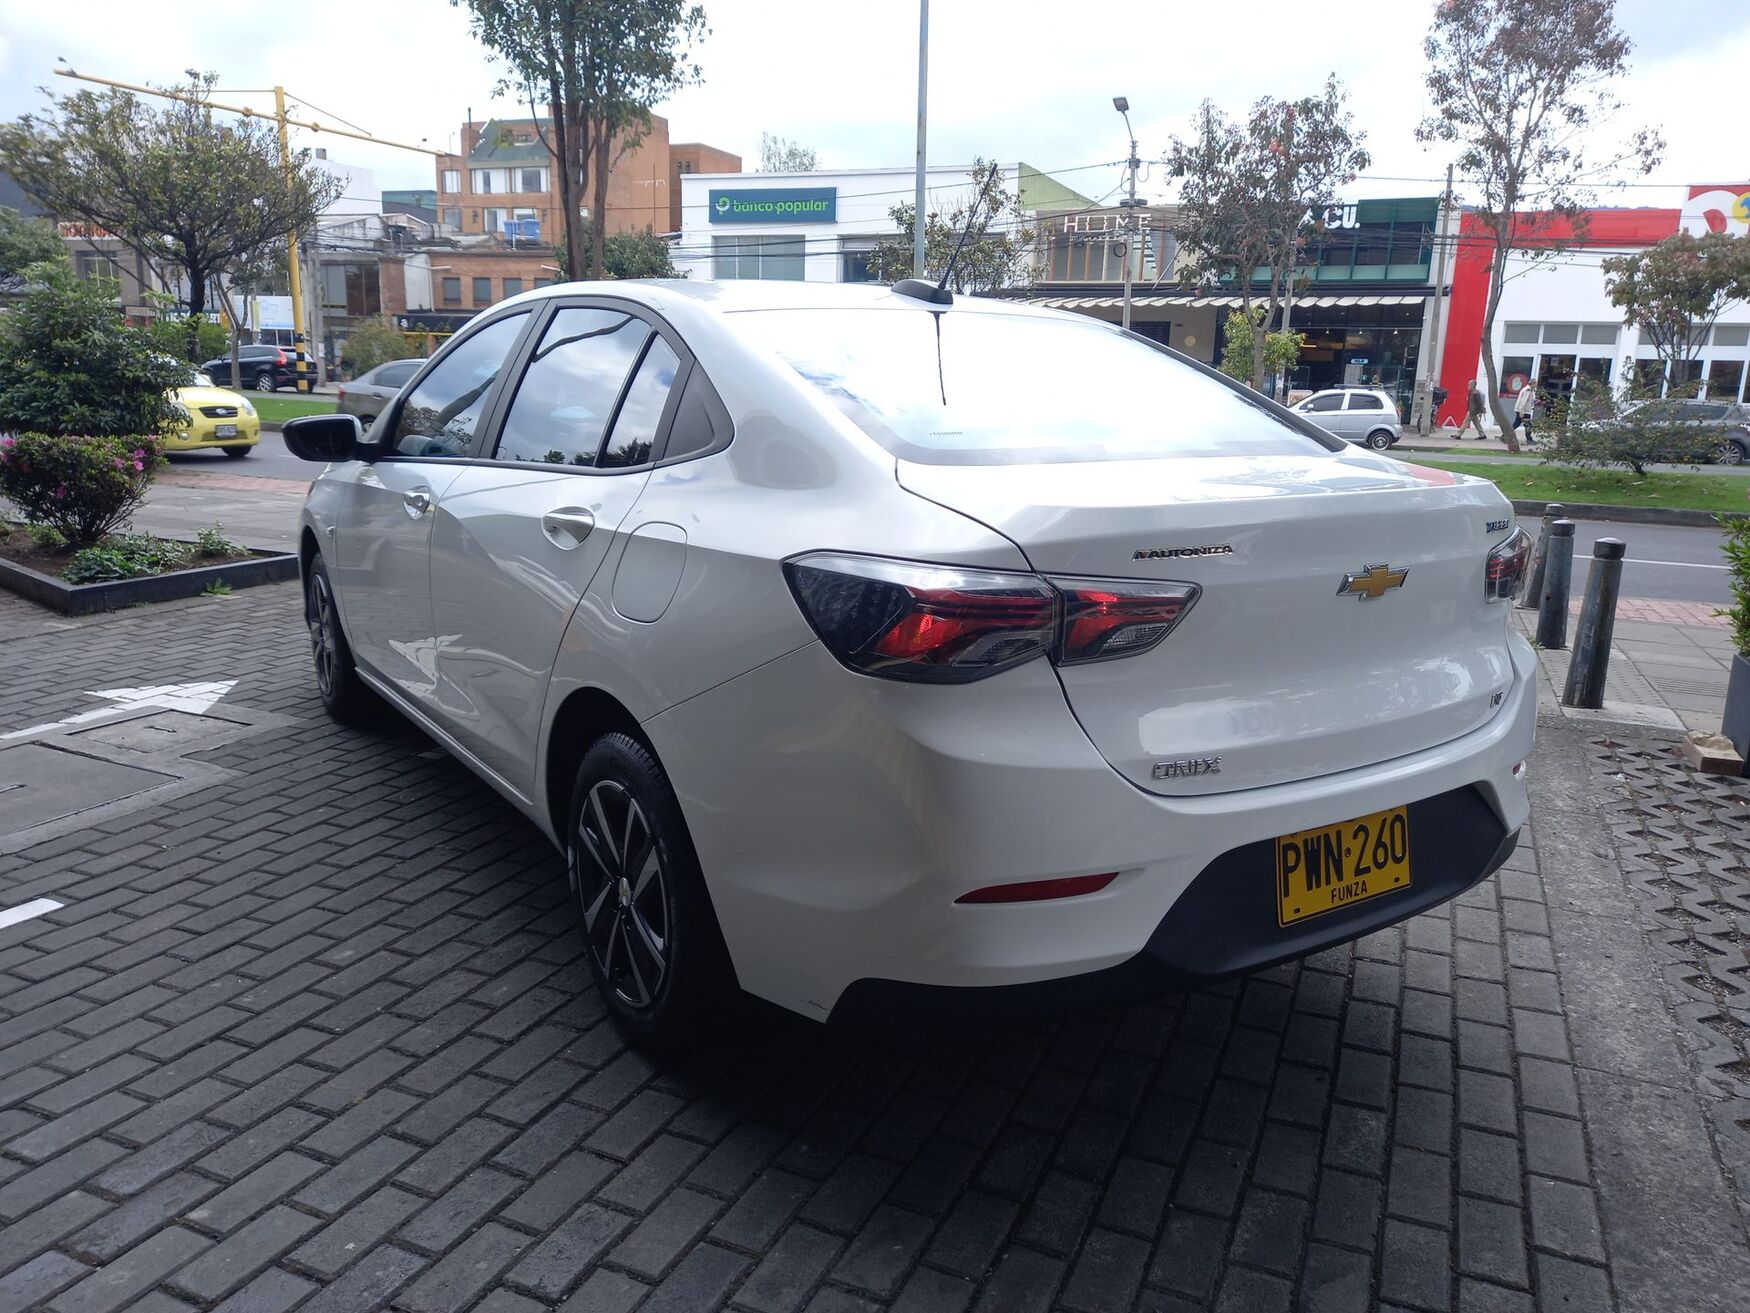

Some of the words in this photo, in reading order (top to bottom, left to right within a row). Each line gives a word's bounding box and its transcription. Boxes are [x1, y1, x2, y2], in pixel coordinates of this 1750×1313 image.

[733, 199, 773, 212] banco
[775, 199, 828, 214] popular
[1331, 870, 1368, 904] FUNZA
